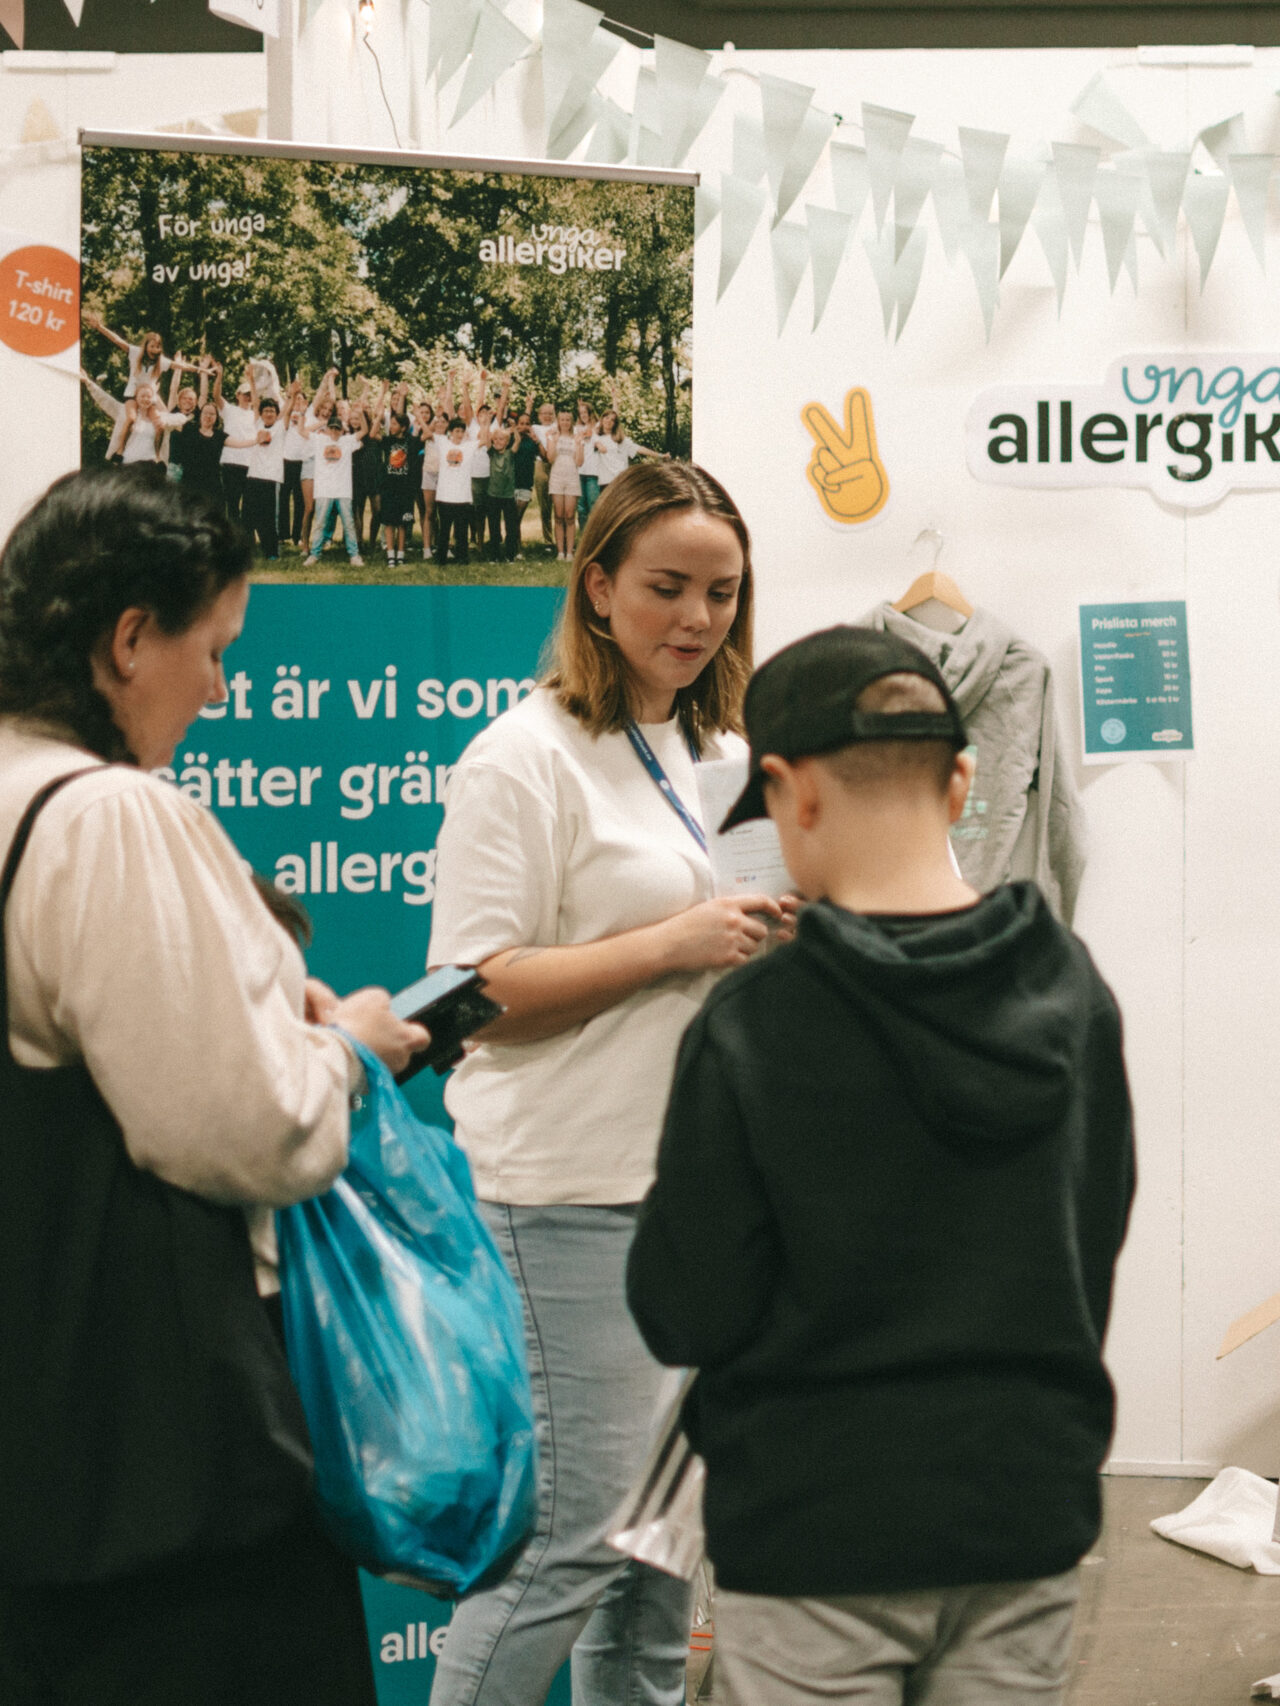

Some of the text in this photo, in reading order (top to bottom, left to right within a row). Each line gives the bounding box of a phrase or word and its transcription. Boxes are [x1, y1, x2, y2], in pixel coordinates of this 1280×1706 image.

[158, 212, 266, 241] För unga
[531, 223, 601, 254] unga
[152, 251, 252, 288] av unga!
[478, 235, 627, 275] allergiker
[15, 269, 74, 305] T-shirt
[9, 299, 67, 332] 120 kr
[1091, 615, 1177, 630] Prislista merch
[271, 664, 330, 720] är
[347, 664, 397, 720] vi
[273, 841, 438, 906] allerg
[379, 1621, 450, 1664] alle
